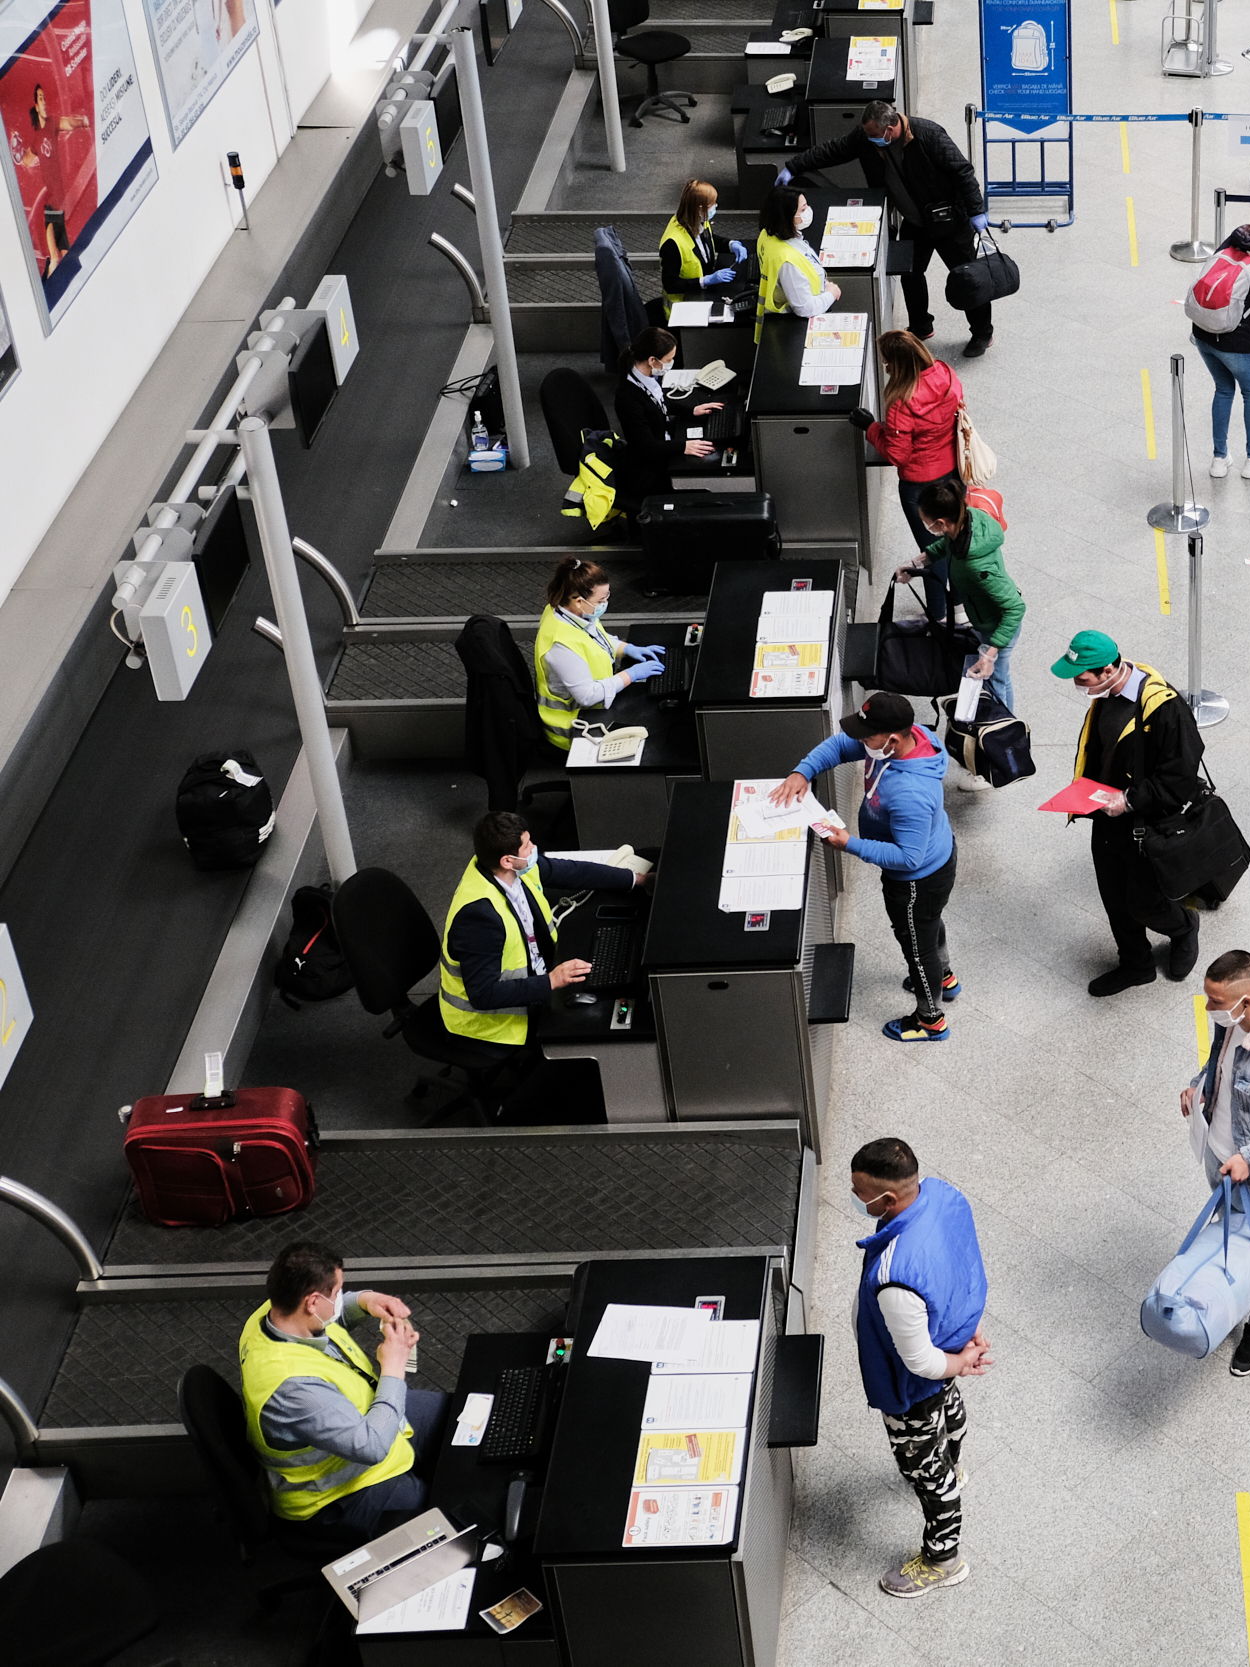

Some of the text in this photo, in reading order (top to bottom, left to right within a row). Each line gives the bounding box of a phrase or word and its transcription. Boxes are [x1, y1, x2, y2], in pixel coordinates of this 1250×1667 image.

[101, 112, 123, 145] SUCCESUL
[426, 127, 436, 168] 5
[340, 307, 350, 347] 4
[180, 605, 198, 658] 3
